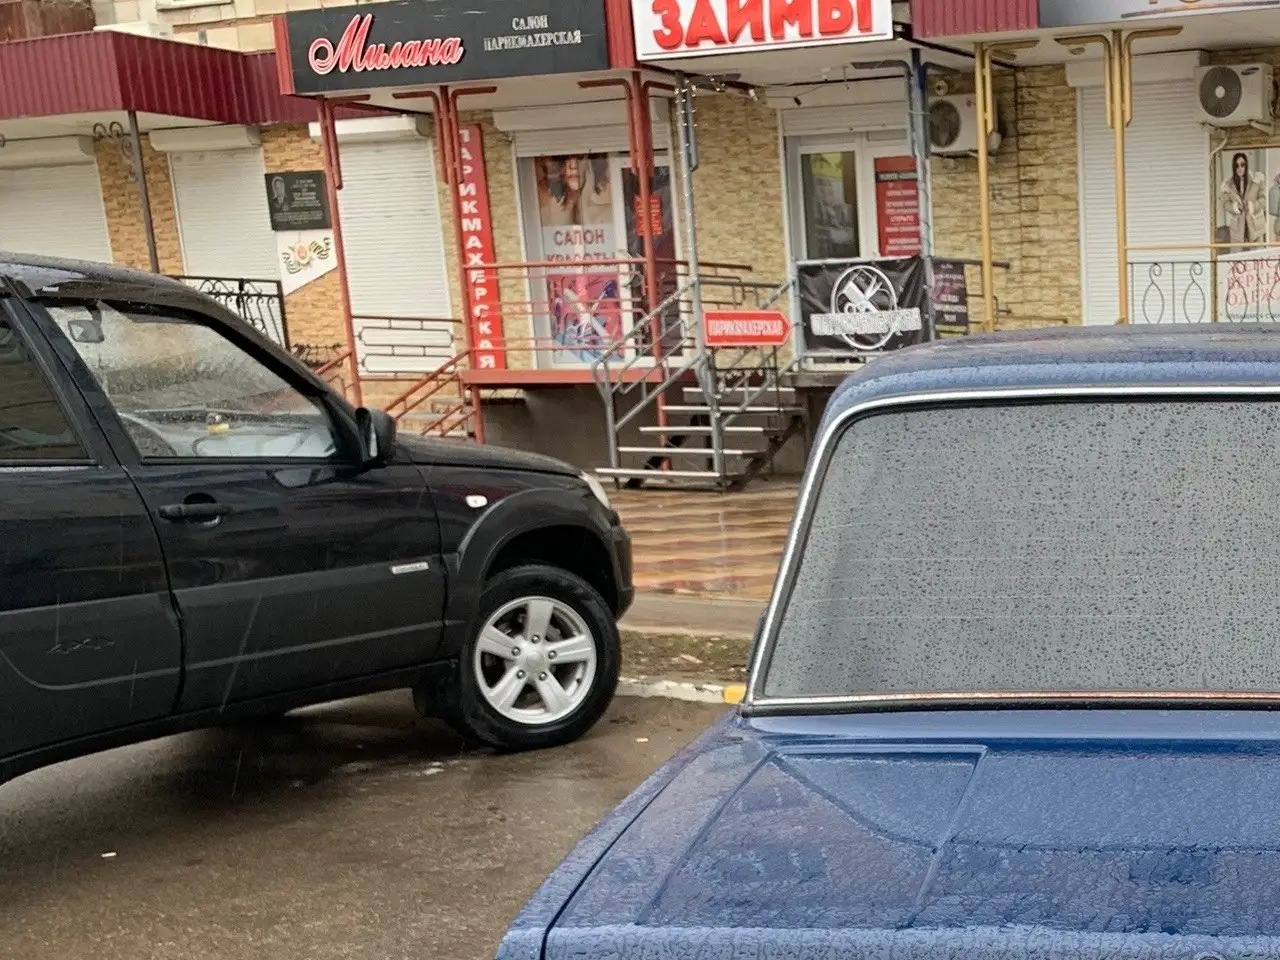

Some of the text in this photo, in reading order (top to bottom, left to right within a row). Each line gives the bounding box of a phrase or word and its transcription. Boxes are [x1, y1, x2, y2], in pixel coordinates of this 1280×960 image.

[511, 14, 549, 31] САЛОН
[308, 13, 464, 75] Милана
[483, 29, 582, 52] ПАРИКМАХЕРСКАЯ
[553, 228, 605, 247] САЛОН
